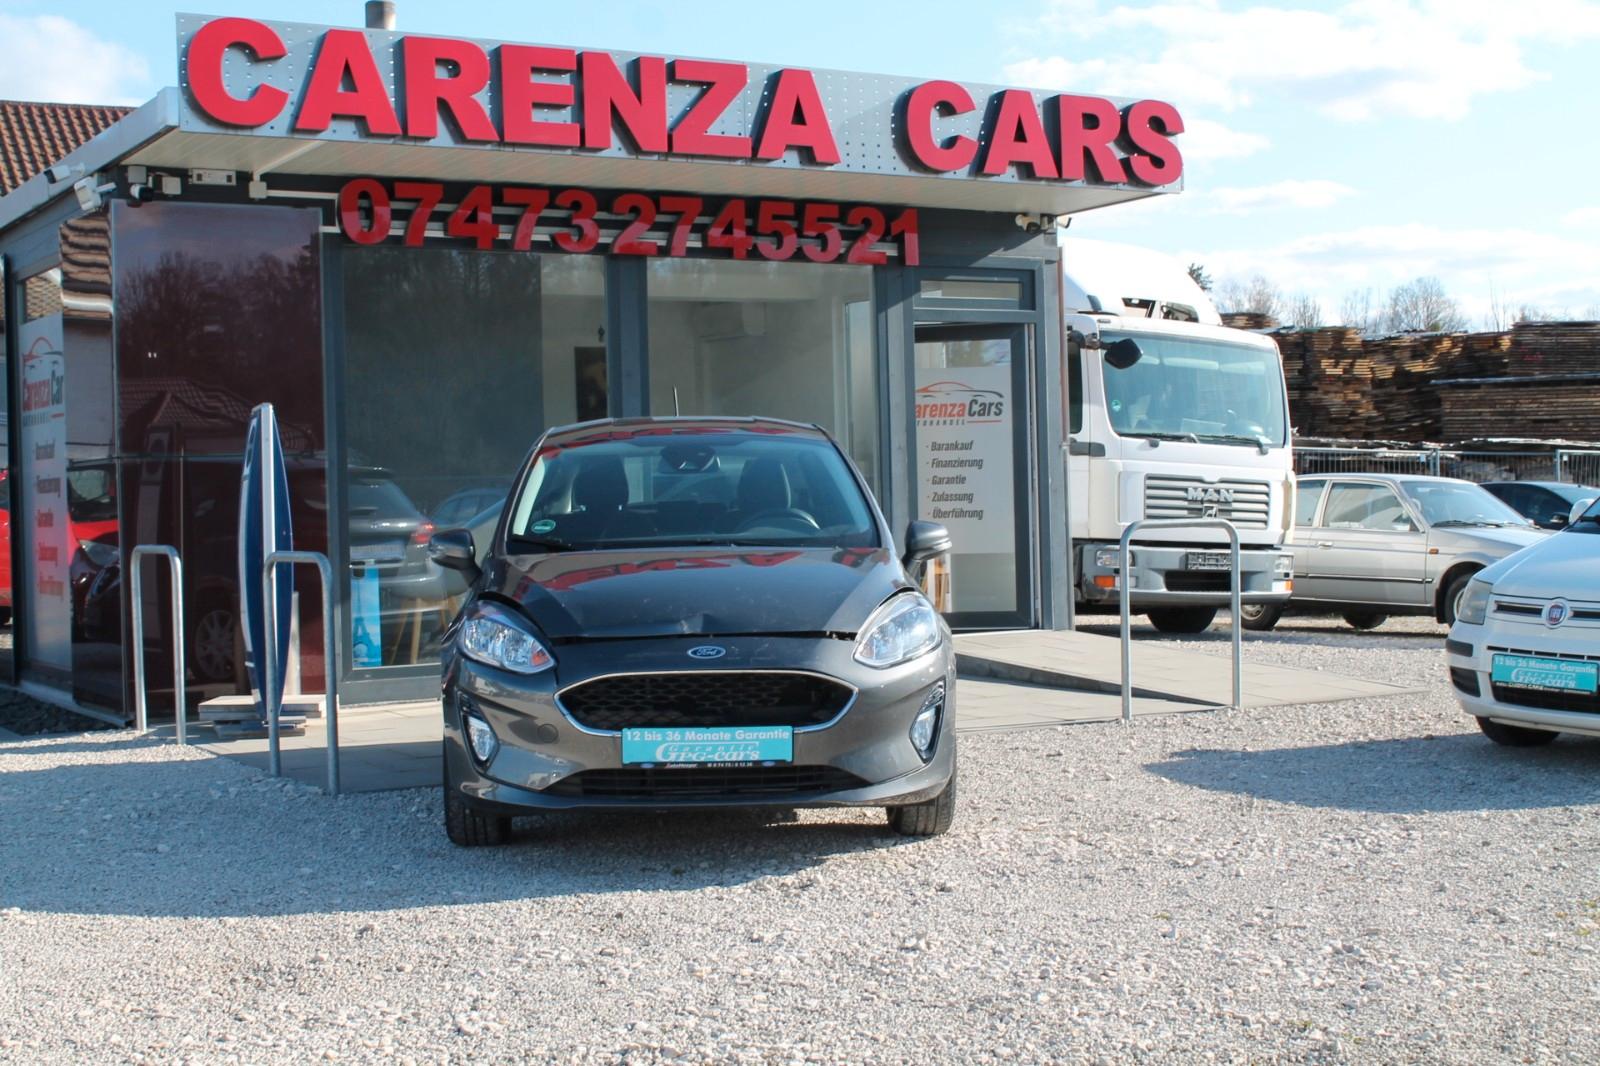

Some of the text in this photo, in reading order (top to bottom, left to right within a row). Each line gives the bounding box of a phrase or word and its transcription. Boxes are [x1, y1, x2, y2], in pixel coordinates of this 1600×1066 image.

[186, 17, 1185, 187] CARENZA CARS
[930, 440, 974, 452] Barankauf
[930, 457, 984, 470] Finanzierung
[931, 474, 967, 486] Garantie
[931, 491, 974, 504] Zulassung
[1187, 487, 1234, 502] MAN
[932, 507, 984, 521] Überführung
[626, 728, 790, 741] 12 bis 36 Monate Garantie
